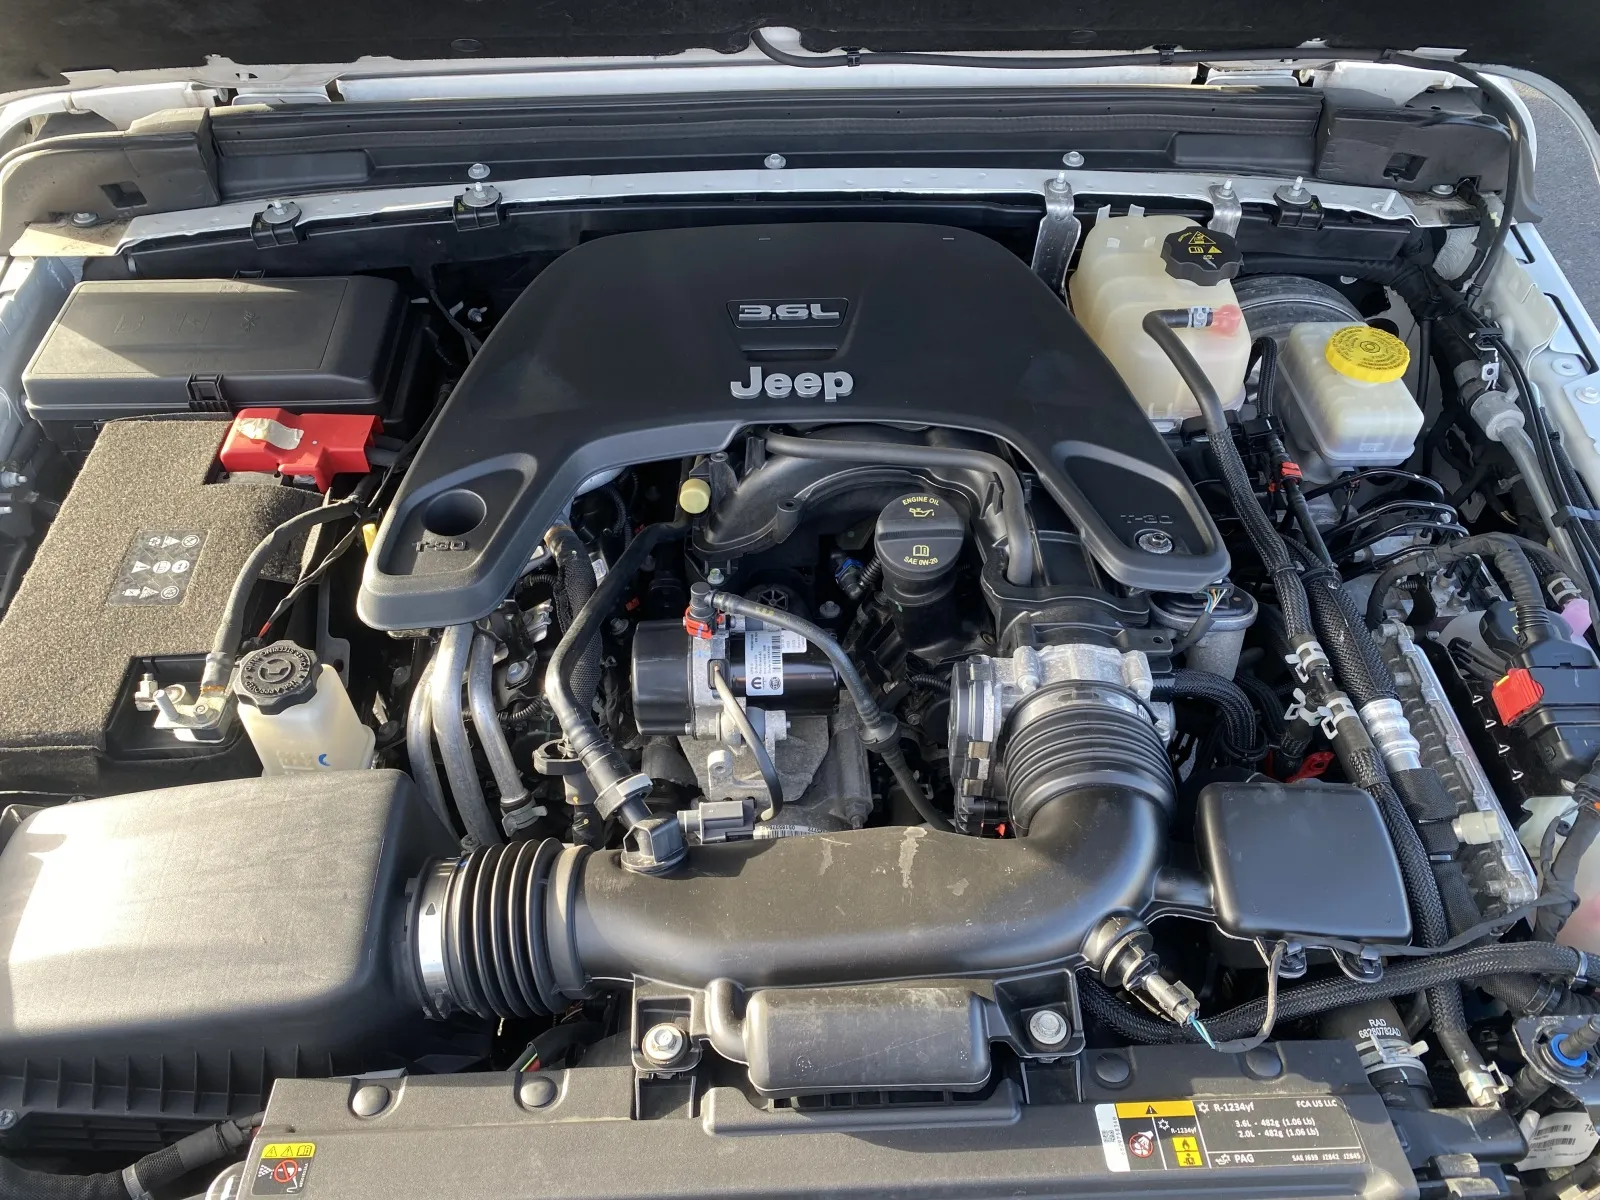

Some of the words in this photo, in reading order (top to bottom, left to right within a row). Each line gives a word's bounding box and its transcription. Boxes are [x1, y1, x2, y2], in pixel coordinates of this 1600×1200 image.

[739, 304, 840, 320] 3.6L
[730, 366, 854, 402] Jeep
[902, 496, 928, 506] ENGINE
[929, 498, 939, 506] OIL
[412, 541, 466, 552] T-30
[904, 556, 918, 565] SAE
[919, 557, 938, 566] 0W-20
[261, 646, 294, 655] STEERING
[293, 652, 310, 672] POWER
[1368, 1018, 1387, 1027] RAD
[1214, 1101, 1255, 1113] R-1234yf
[1297, 1100, 1311, 1108] FCA
[1312, 1100, 1323, 1108] US
[1234, 1119, 1252, 1128] 3.6L
[1261, 1119, 1280, 1128] 482g
[1282, 1118, 1301, 1128] (1.06
[1302, 1117, 1316, 1126] Lb)
[1171, 1126, 1197, 1135] R-1234yf
[1238, 1130, 1256, 1138] 2.0L
[1264, 1129, 1284, 1138] 482g
[1285, 1128, 1305, 1138] (1.06
[1306, 1127, 1320, 1137] Lb)
[1234, 1154, 1255, 1164] PAG
[1291, 1154, 1304, 1162] SAE
